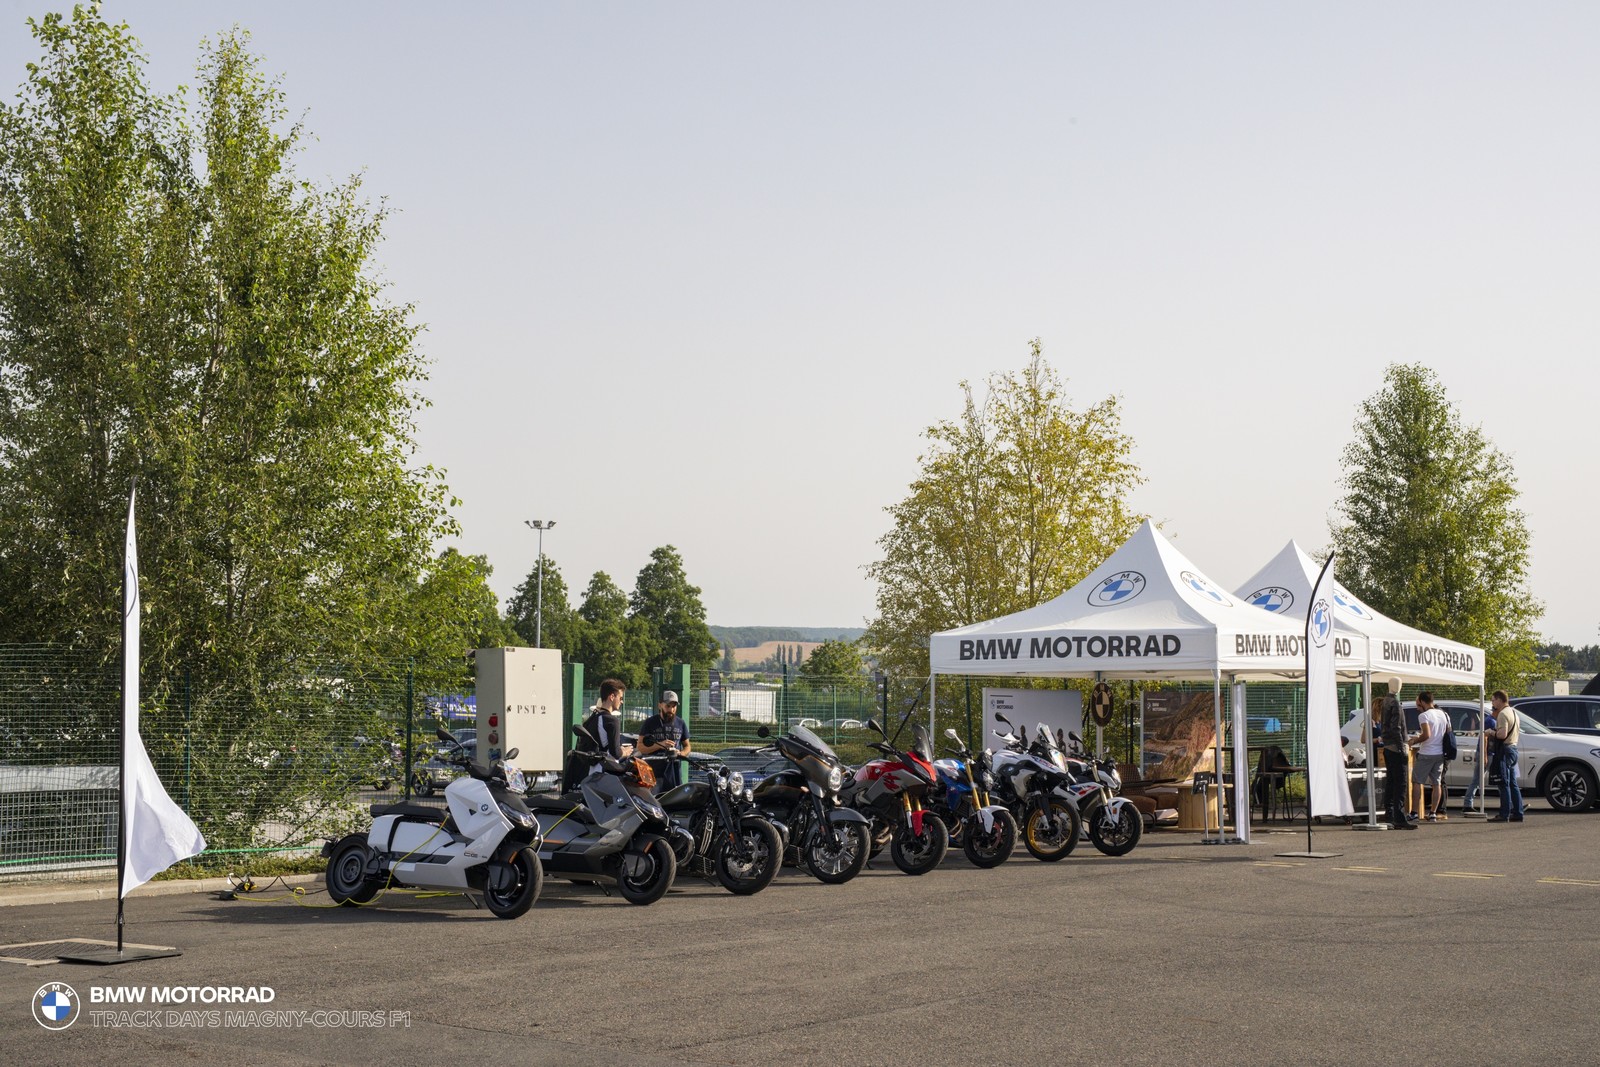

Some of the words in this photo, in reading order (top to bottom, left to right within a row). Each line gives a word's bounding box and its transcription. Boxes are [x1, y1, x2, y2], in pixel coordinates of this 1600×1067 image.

[1104, 573, 1142, 586] BMW
[1253, 588, 1290, 599] BMW
[960, 638, 1022, 660] BMW
[1030, 635, 1181, 659] MOTORRAD
[1235, 634, 1271, 656] BMW
[1276, 635, 1351, 657] MOTAD
[1383, 641, 1410, 663] BMW
[1414, 645, 1474, 672] MOTORRAD
[517, 705, 537, 714] PST
[540, 705, 546, 714] 2
